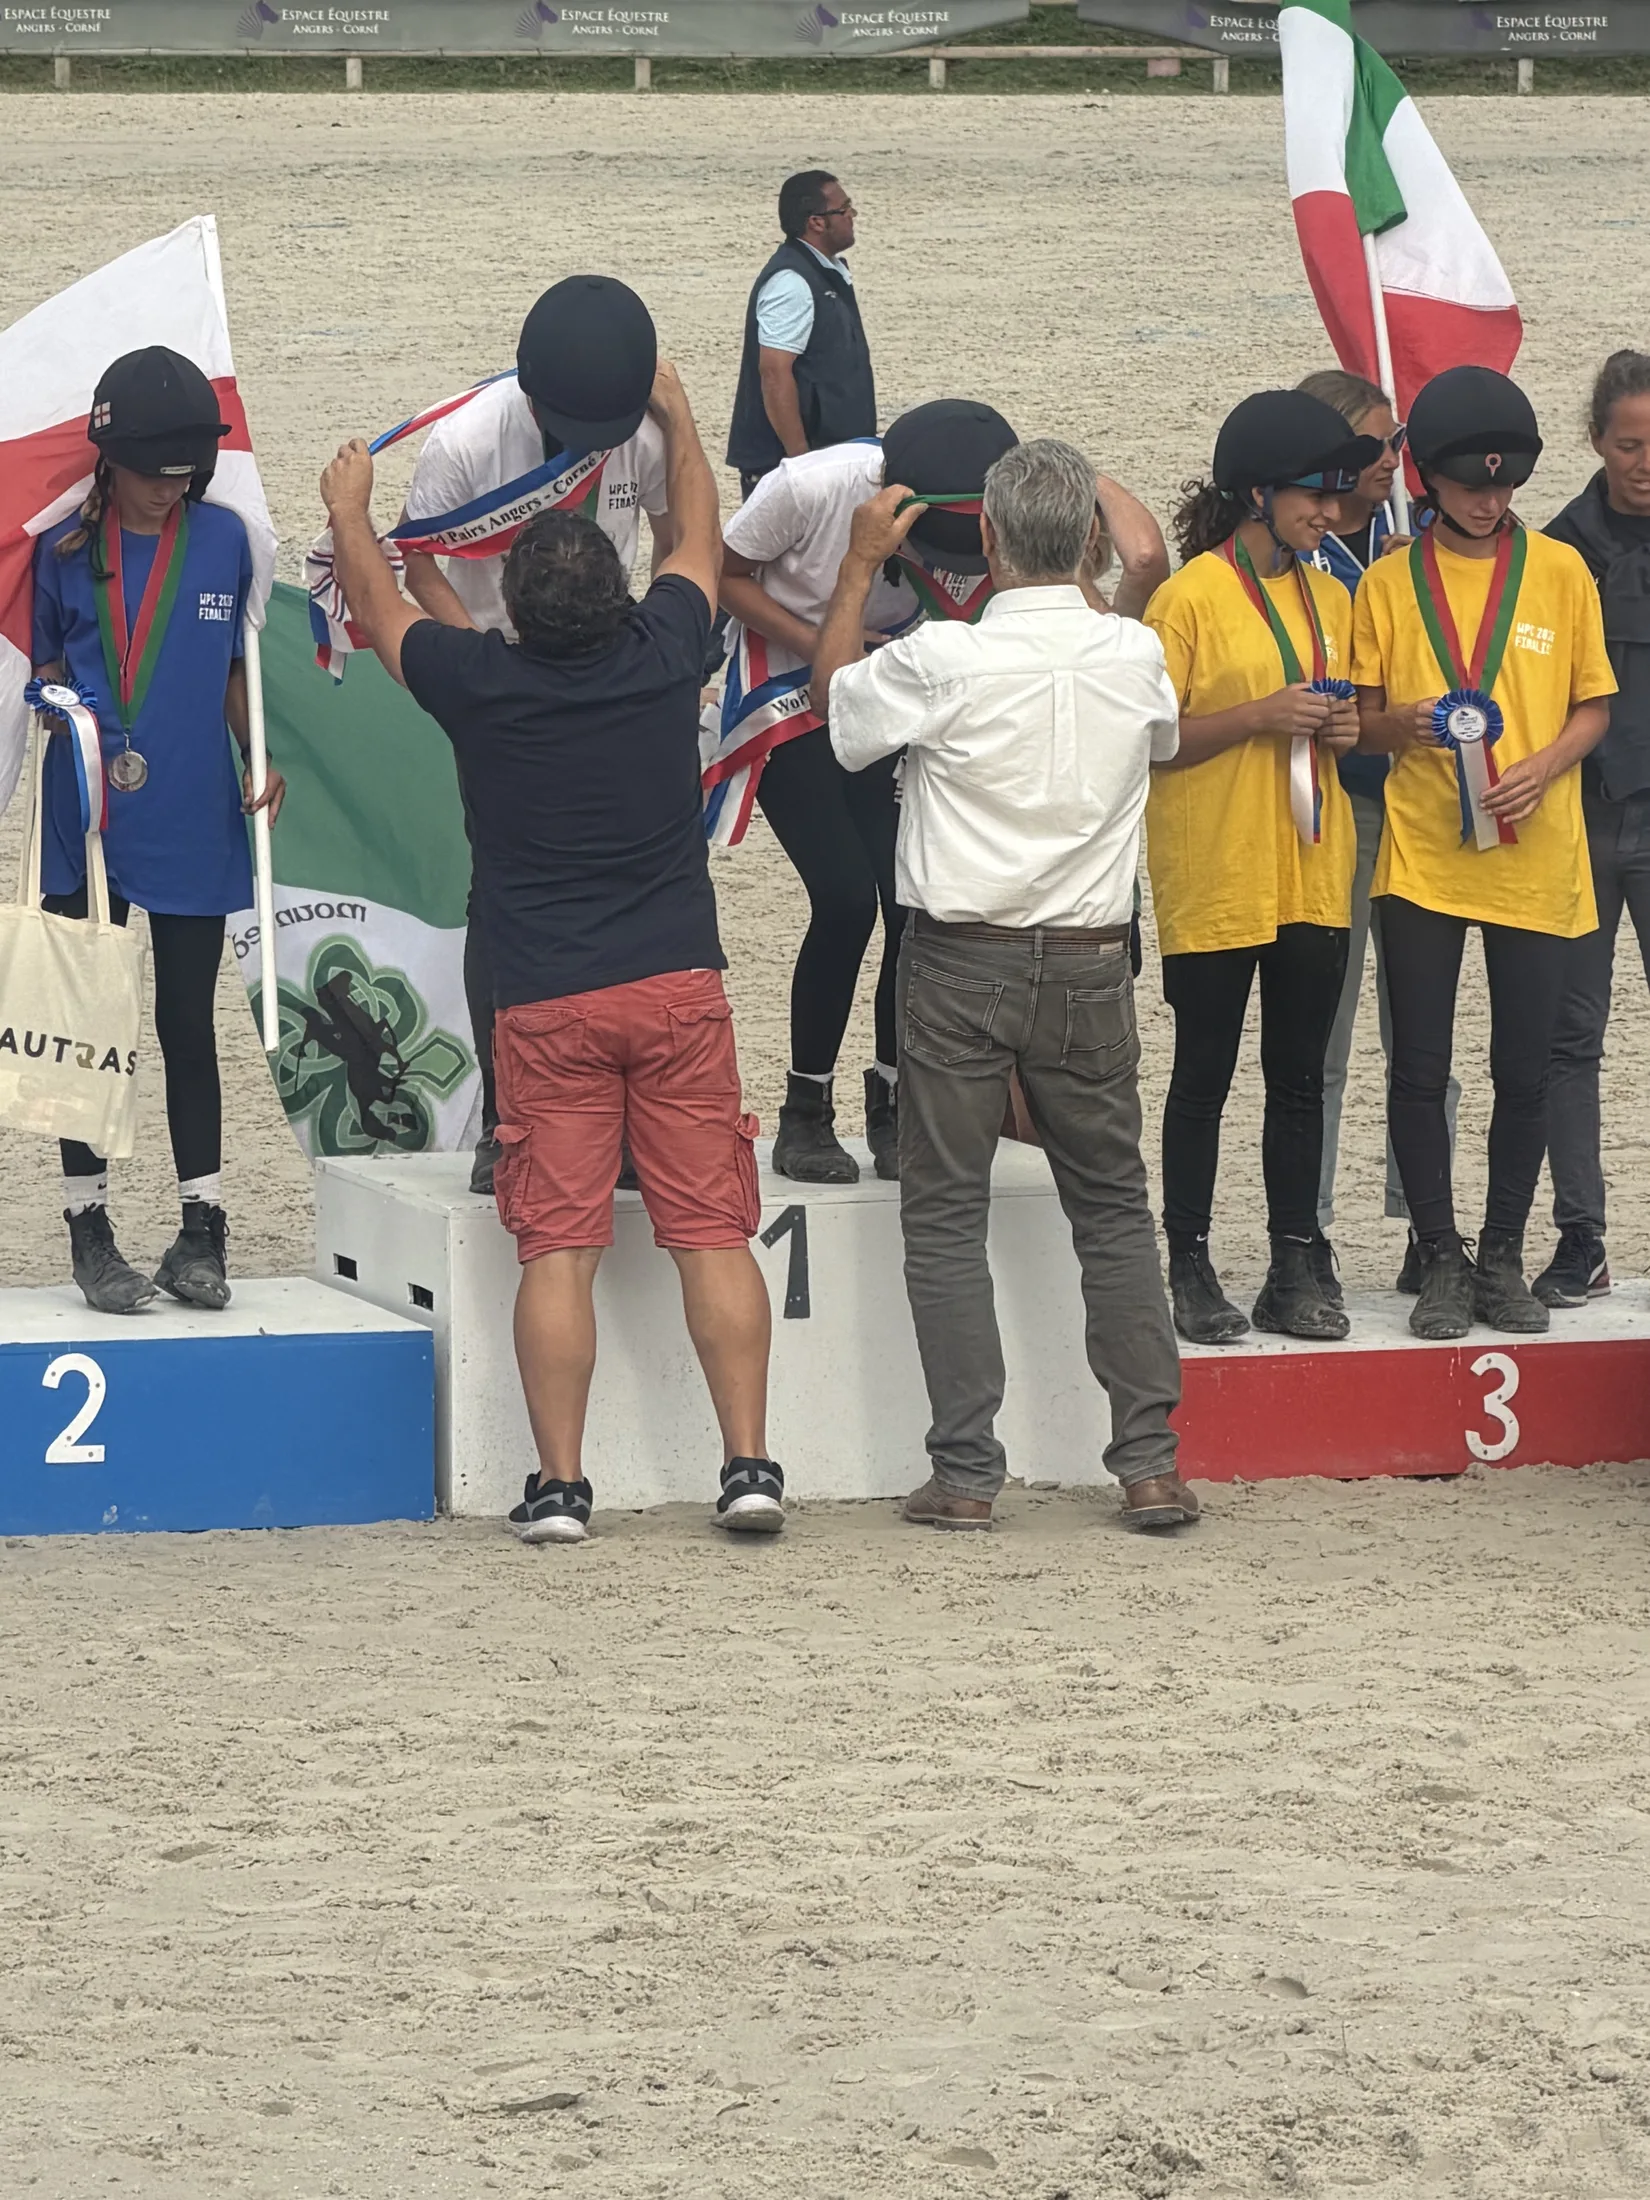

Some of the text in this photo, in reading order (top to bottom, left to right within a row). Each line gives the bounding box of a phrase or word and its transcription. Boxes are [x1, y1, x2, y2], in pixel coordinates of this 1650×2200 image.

[4, 8, 47, 20] ESPACE
[282, 8, 324, 21] ESPACE
[561, 9, 604, 21] ESPACE
[841, 12, 884, 24] ESPACE
[1210, 15, 1254, 28] ESPACE
[1496, 16, 1540, 28] ESPACE
[1221, 31, 1262, 42] ANGERS
[446, 524, 487, 542] Pairs
[489, 497, 542, 531] Angers
[759, 1205, 810, 1319] 1
[42, 1353, 106, 1463] 2
[1465, 1352, 1519, 1461] 3
